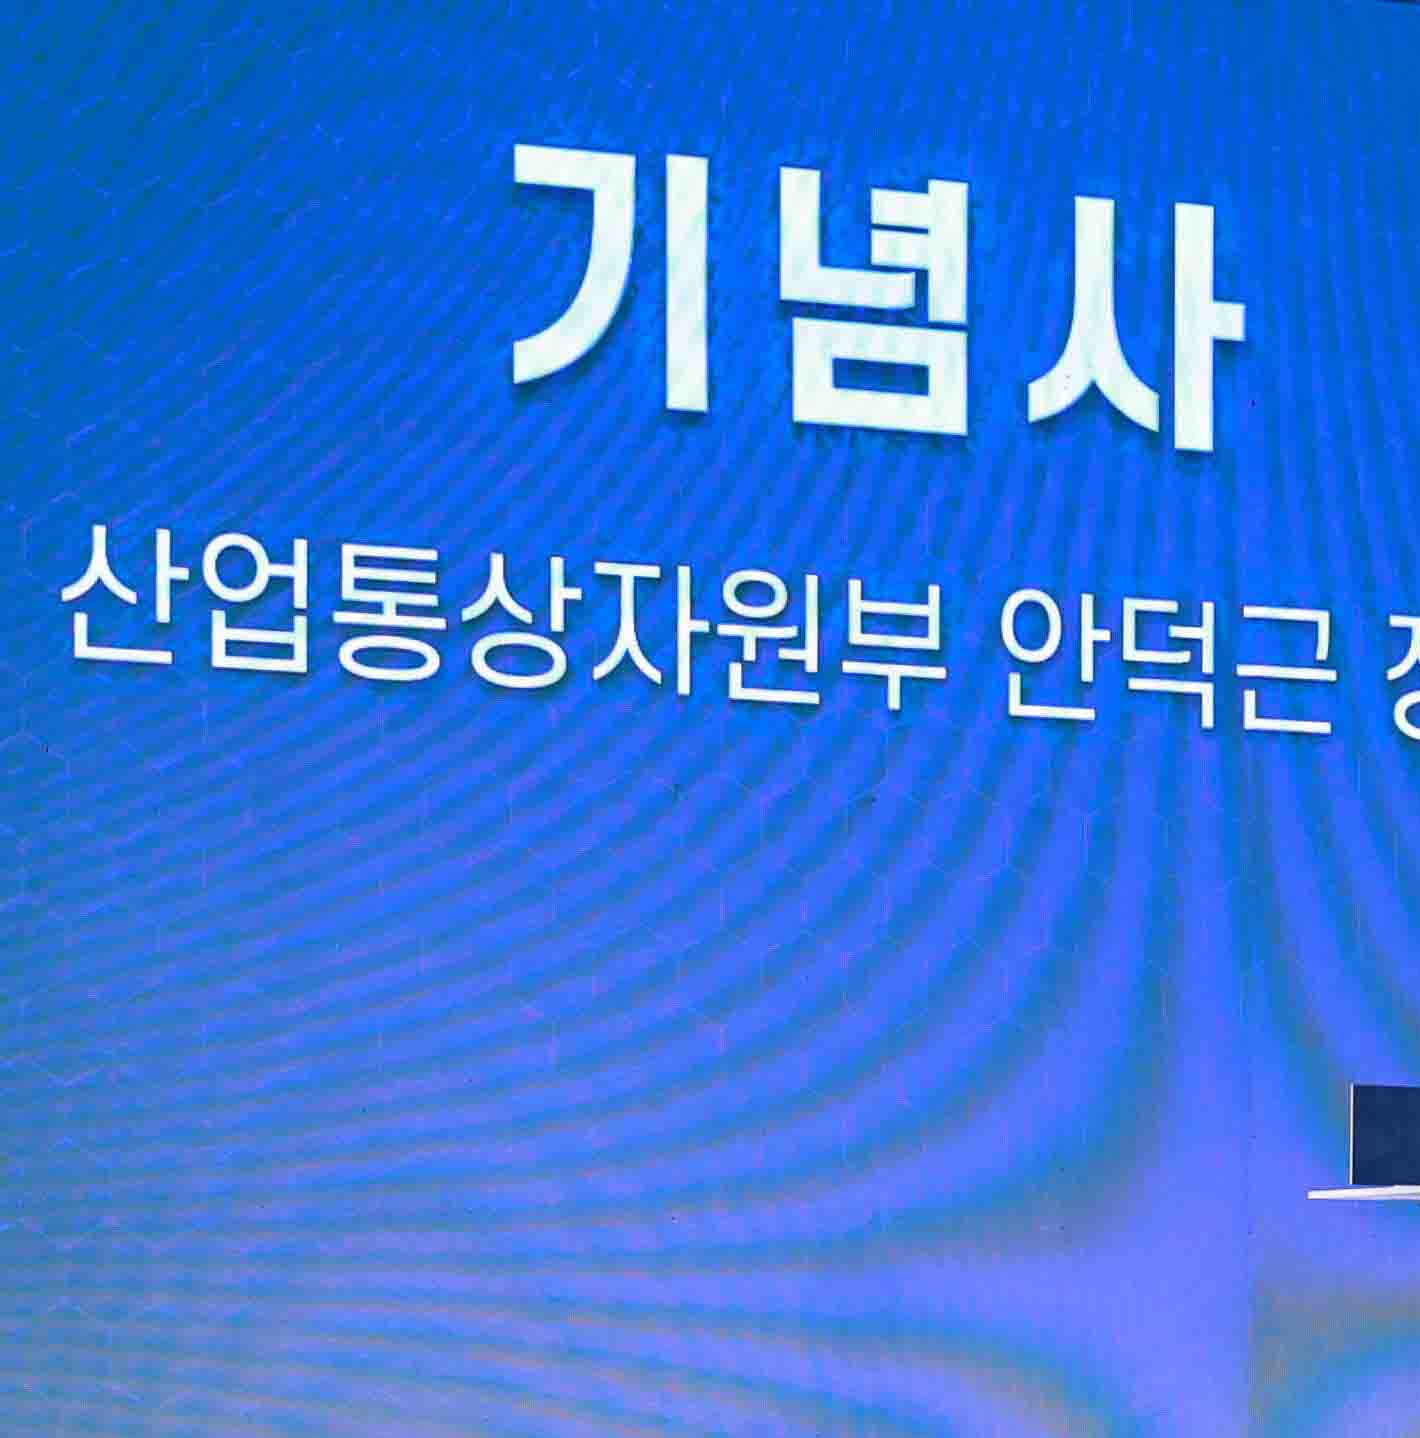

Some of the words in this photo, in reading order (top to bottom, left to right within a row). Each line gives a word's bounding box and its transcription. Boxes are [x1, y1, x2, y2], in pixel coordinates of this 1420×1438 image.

[513, 144, 1245, 450] 기념사
[61, 524, 947, 711] 산업통상자원부
[1000, 587, 1338, 735] 안덕근
